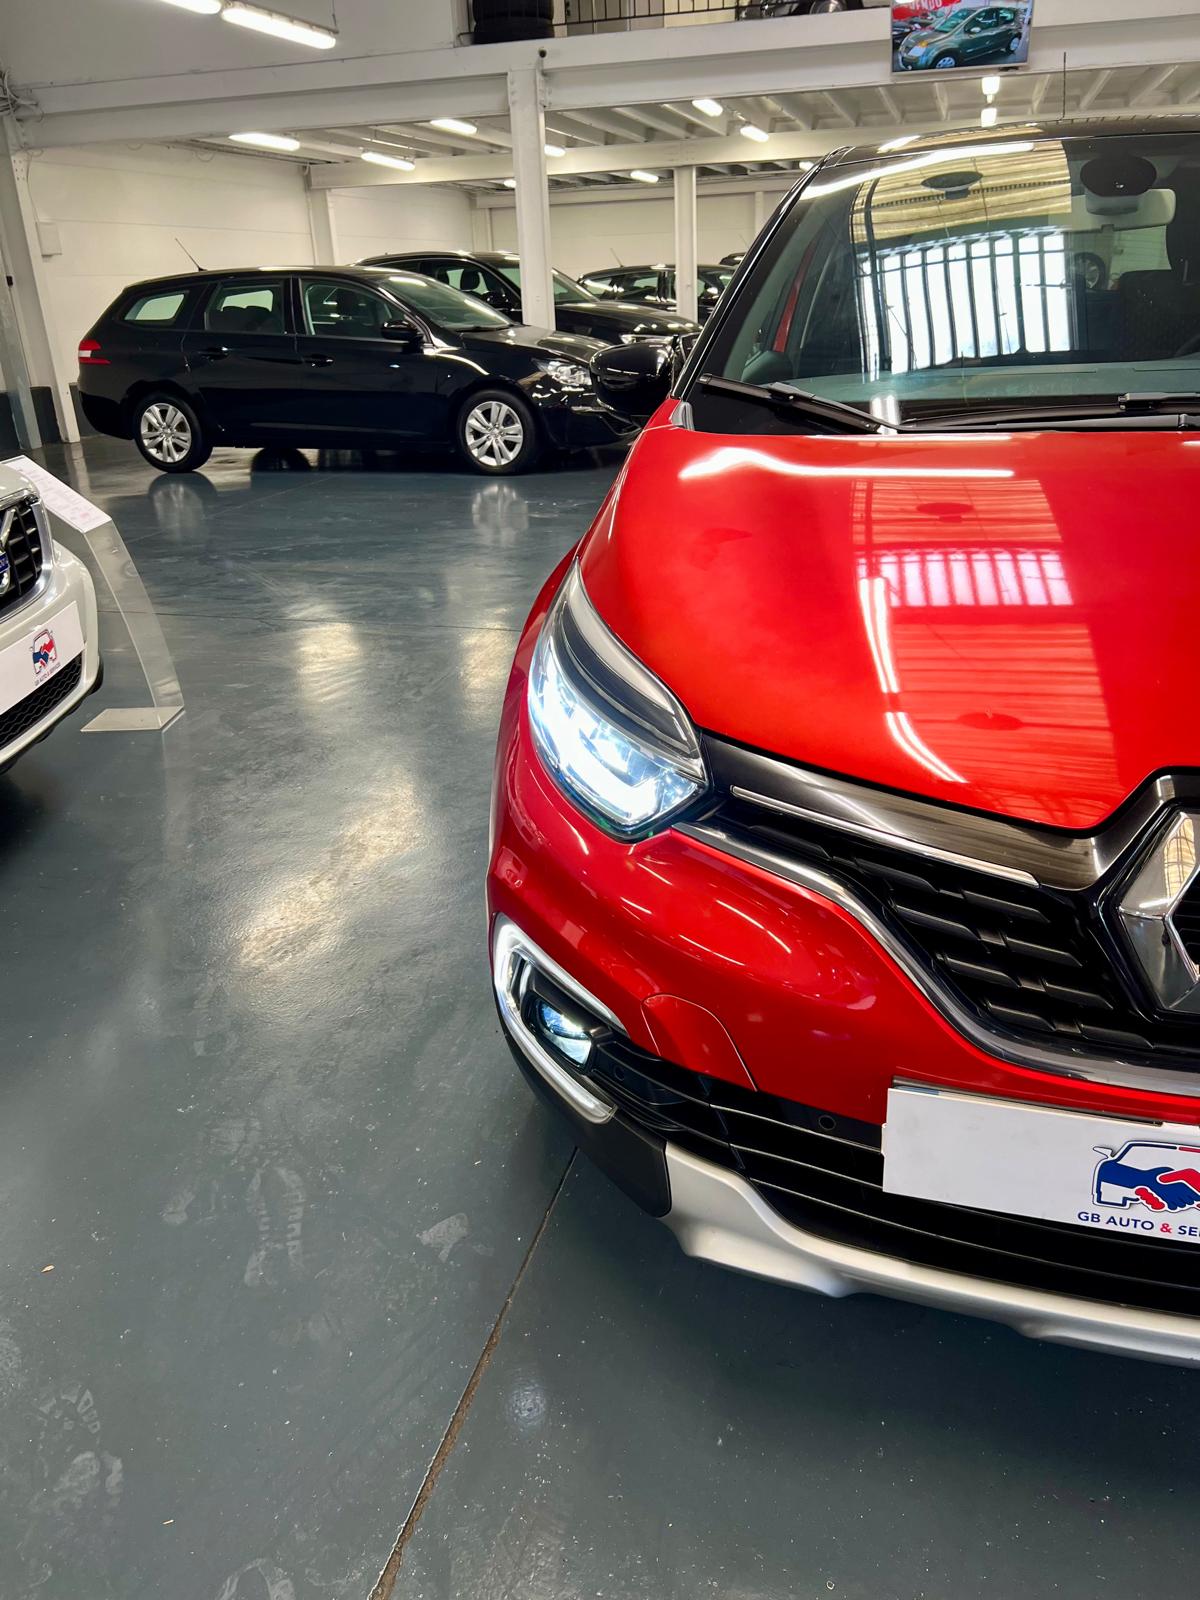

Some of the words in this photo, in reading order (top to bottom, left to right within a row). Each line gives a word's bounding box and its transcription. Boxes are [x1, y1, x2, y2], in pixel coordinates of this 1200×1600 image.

[1077, 1211, 1101, 1223] GB
[1106, 1216, 1155, 1230] AUTO
[1160, 1223, 1172, 1233] &
[1177, 1225, 1200, 1237] SE
